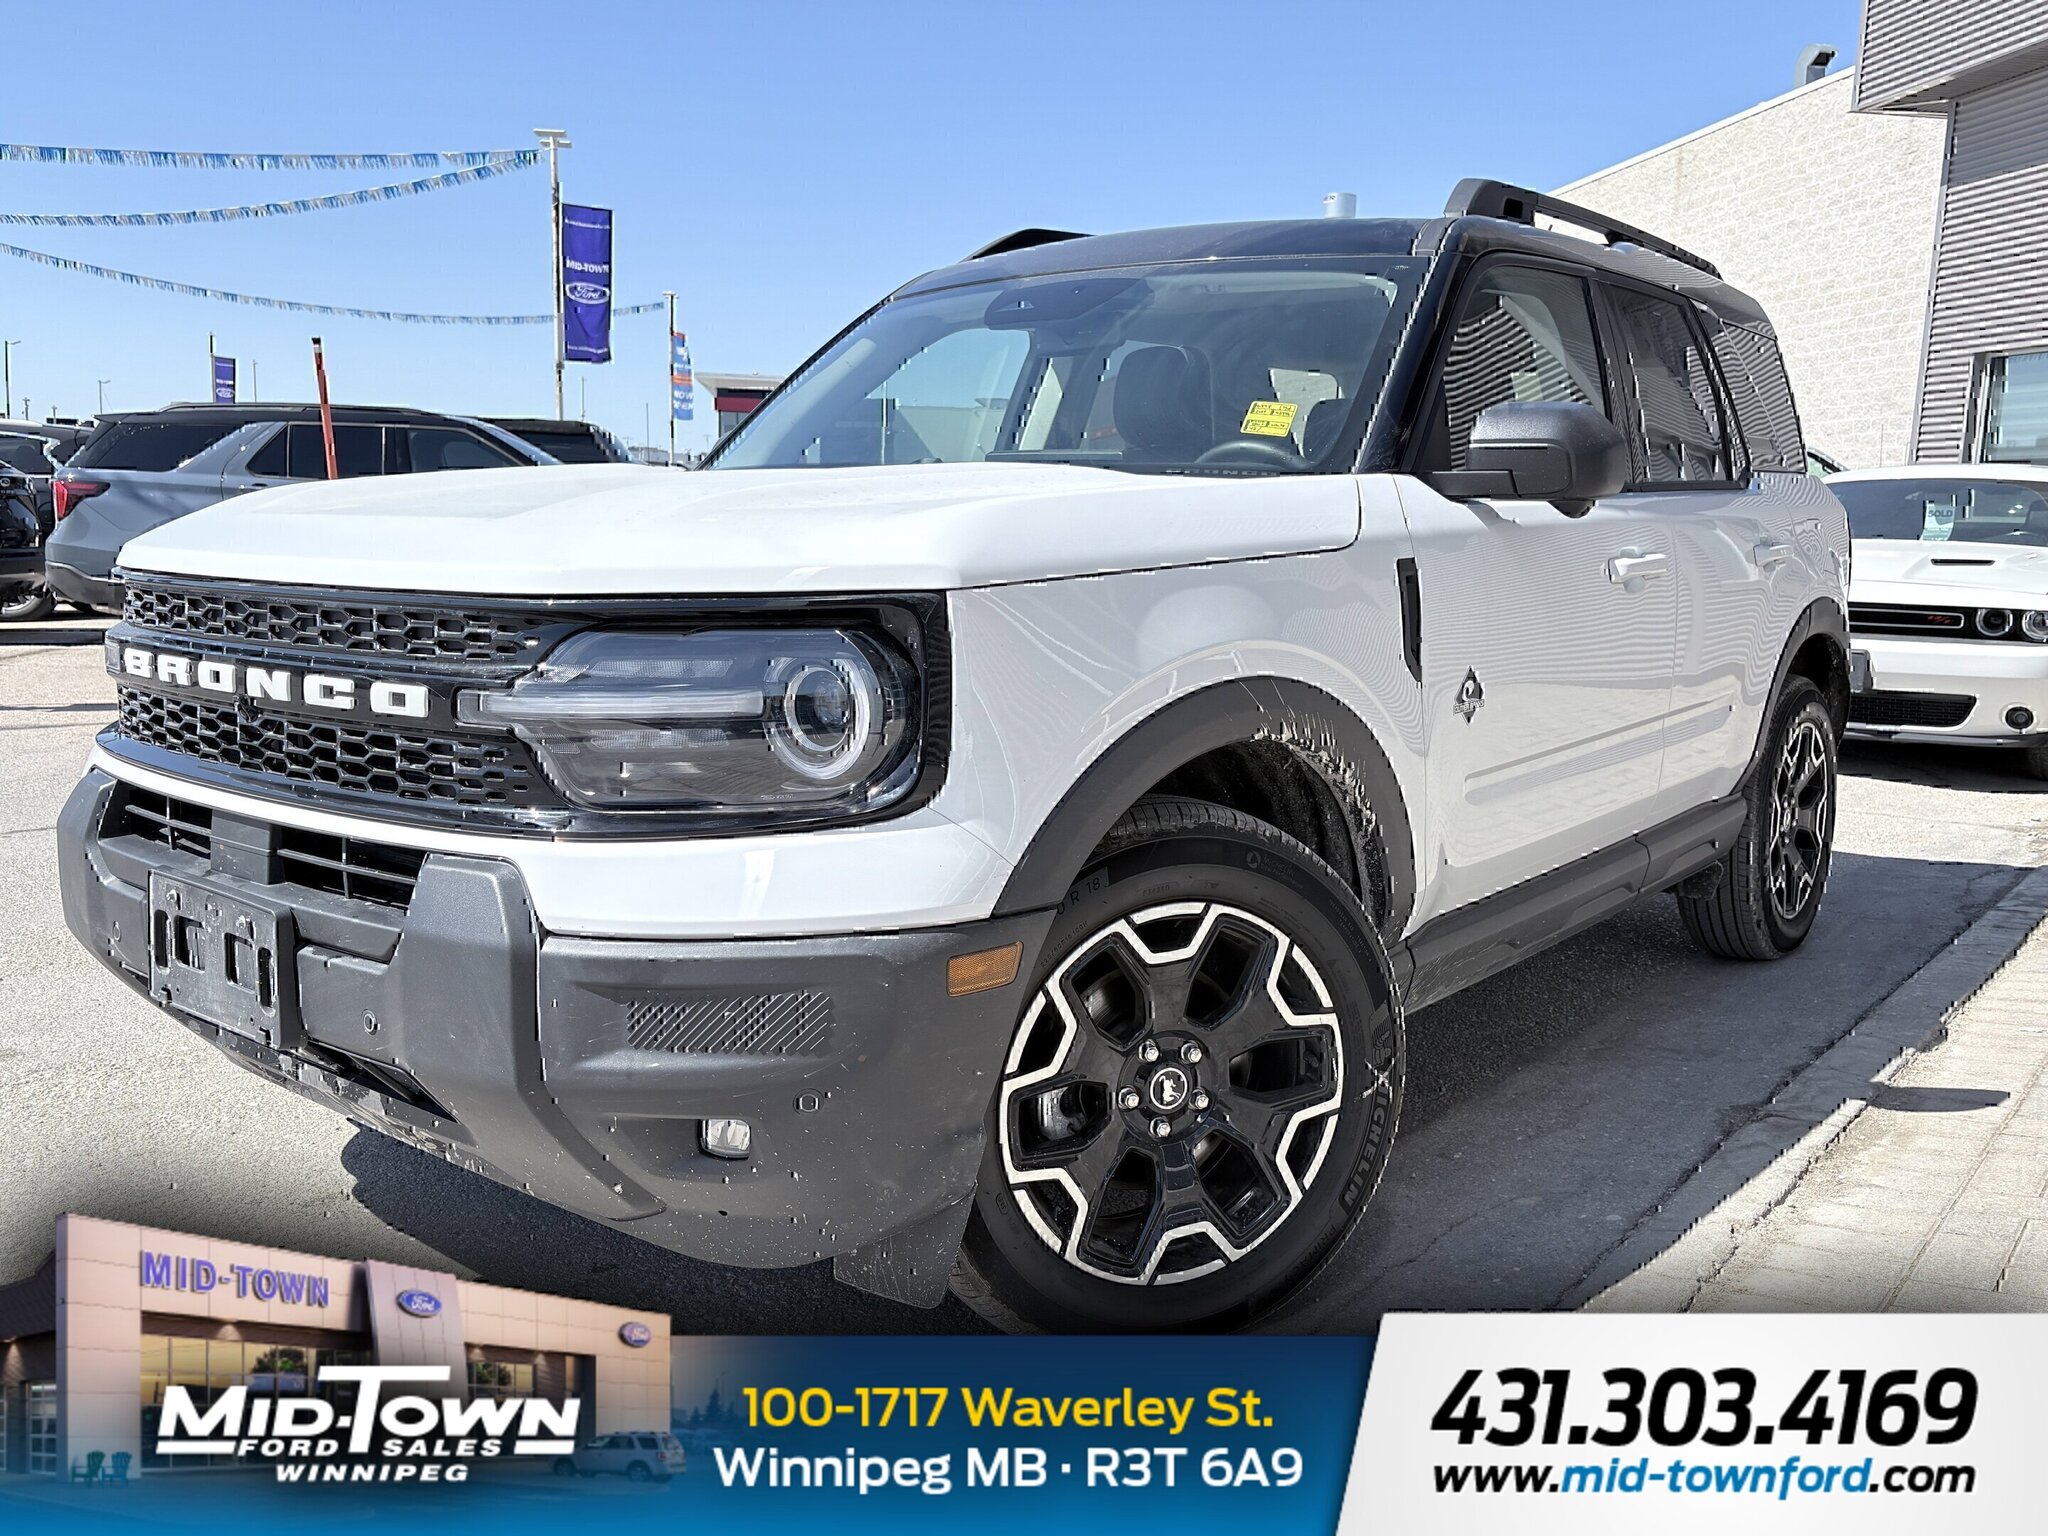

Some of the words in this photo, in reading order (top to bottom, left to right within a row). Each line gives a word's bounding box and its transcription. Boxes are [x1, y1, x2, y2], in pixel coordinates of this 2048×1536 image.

[574, 286, 601, 299] Ford
[1928, 509, 1954, 518] SOLD
[124, 648, 430, 718] BRONCO
[1086, 878, 1101, 893] 18
